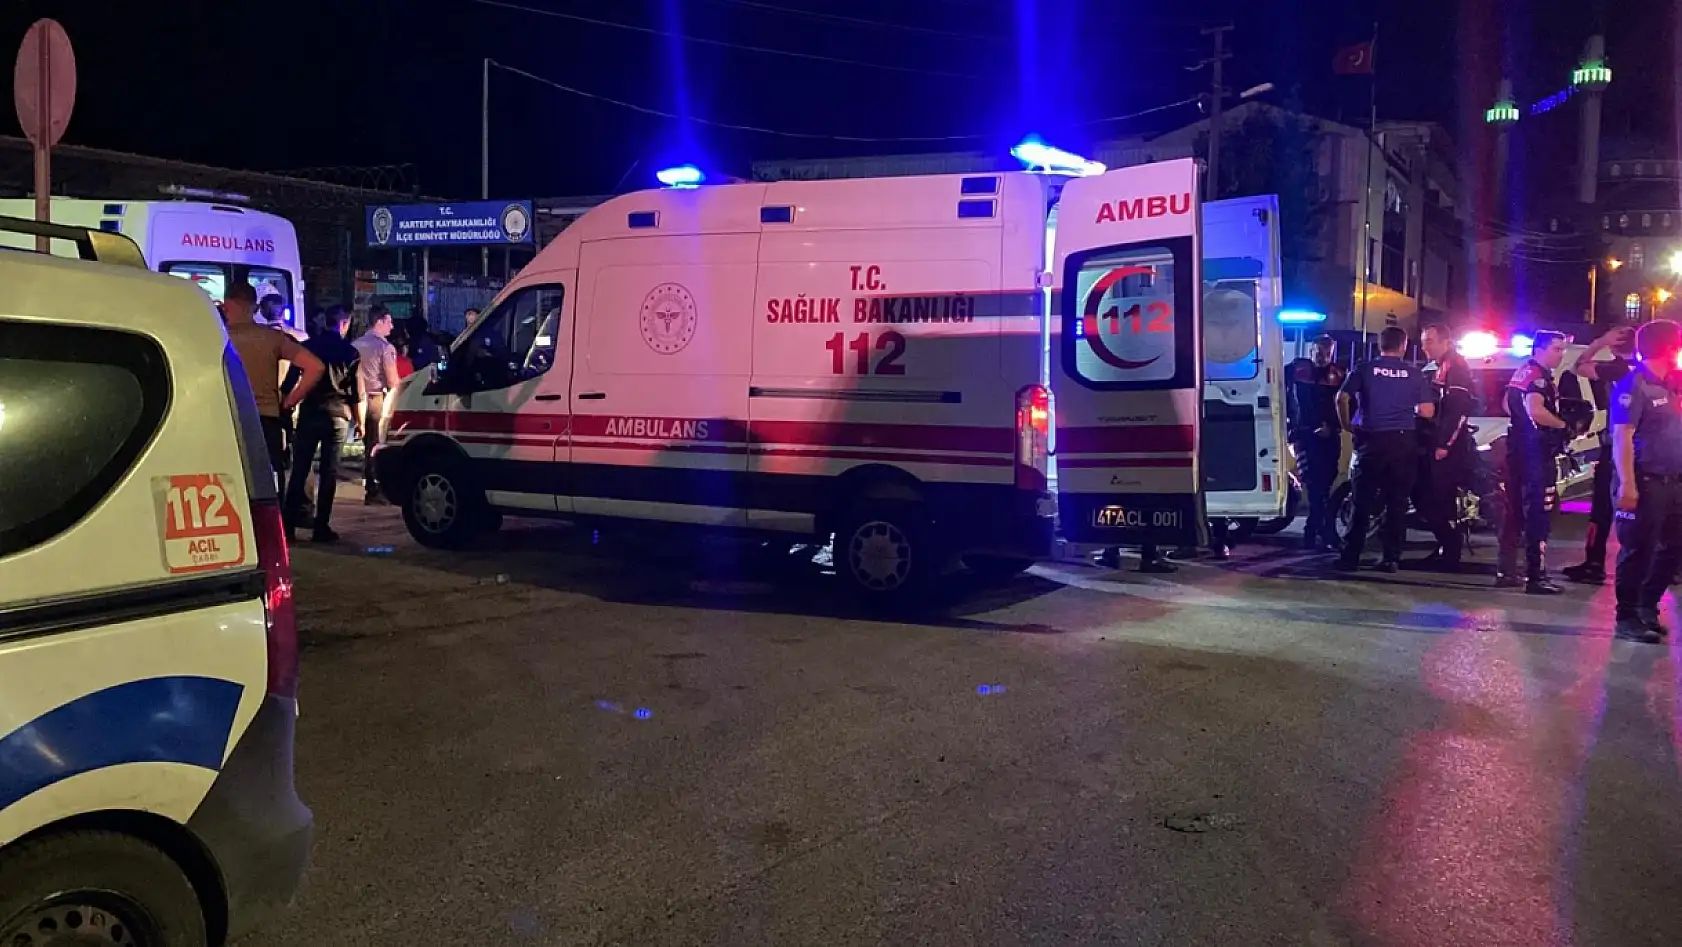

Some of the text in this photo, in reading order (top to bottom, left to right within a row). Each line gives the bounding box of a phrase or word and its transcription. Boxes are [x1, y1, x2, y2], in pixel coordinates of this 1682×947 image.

[1096, 192, 1190, 224] AMBU
[399, 220, 434, 229] KARTEPE
[182, 232, 275, 252] AMBULANS
[850, 265, 886, 291] T.C.
[766, 292, 975, 324] SAĞLIK BAKANLIĞI
[1101, 301, 1173, 336] 112
[825, 331, 907, 375] 112
[604, 417, 709, 439] AMBULANS
[166, 484, 229, 531] 112
[1115, 510, 1147, 526] ACL
[1153, 511, 1177, 526] 001
